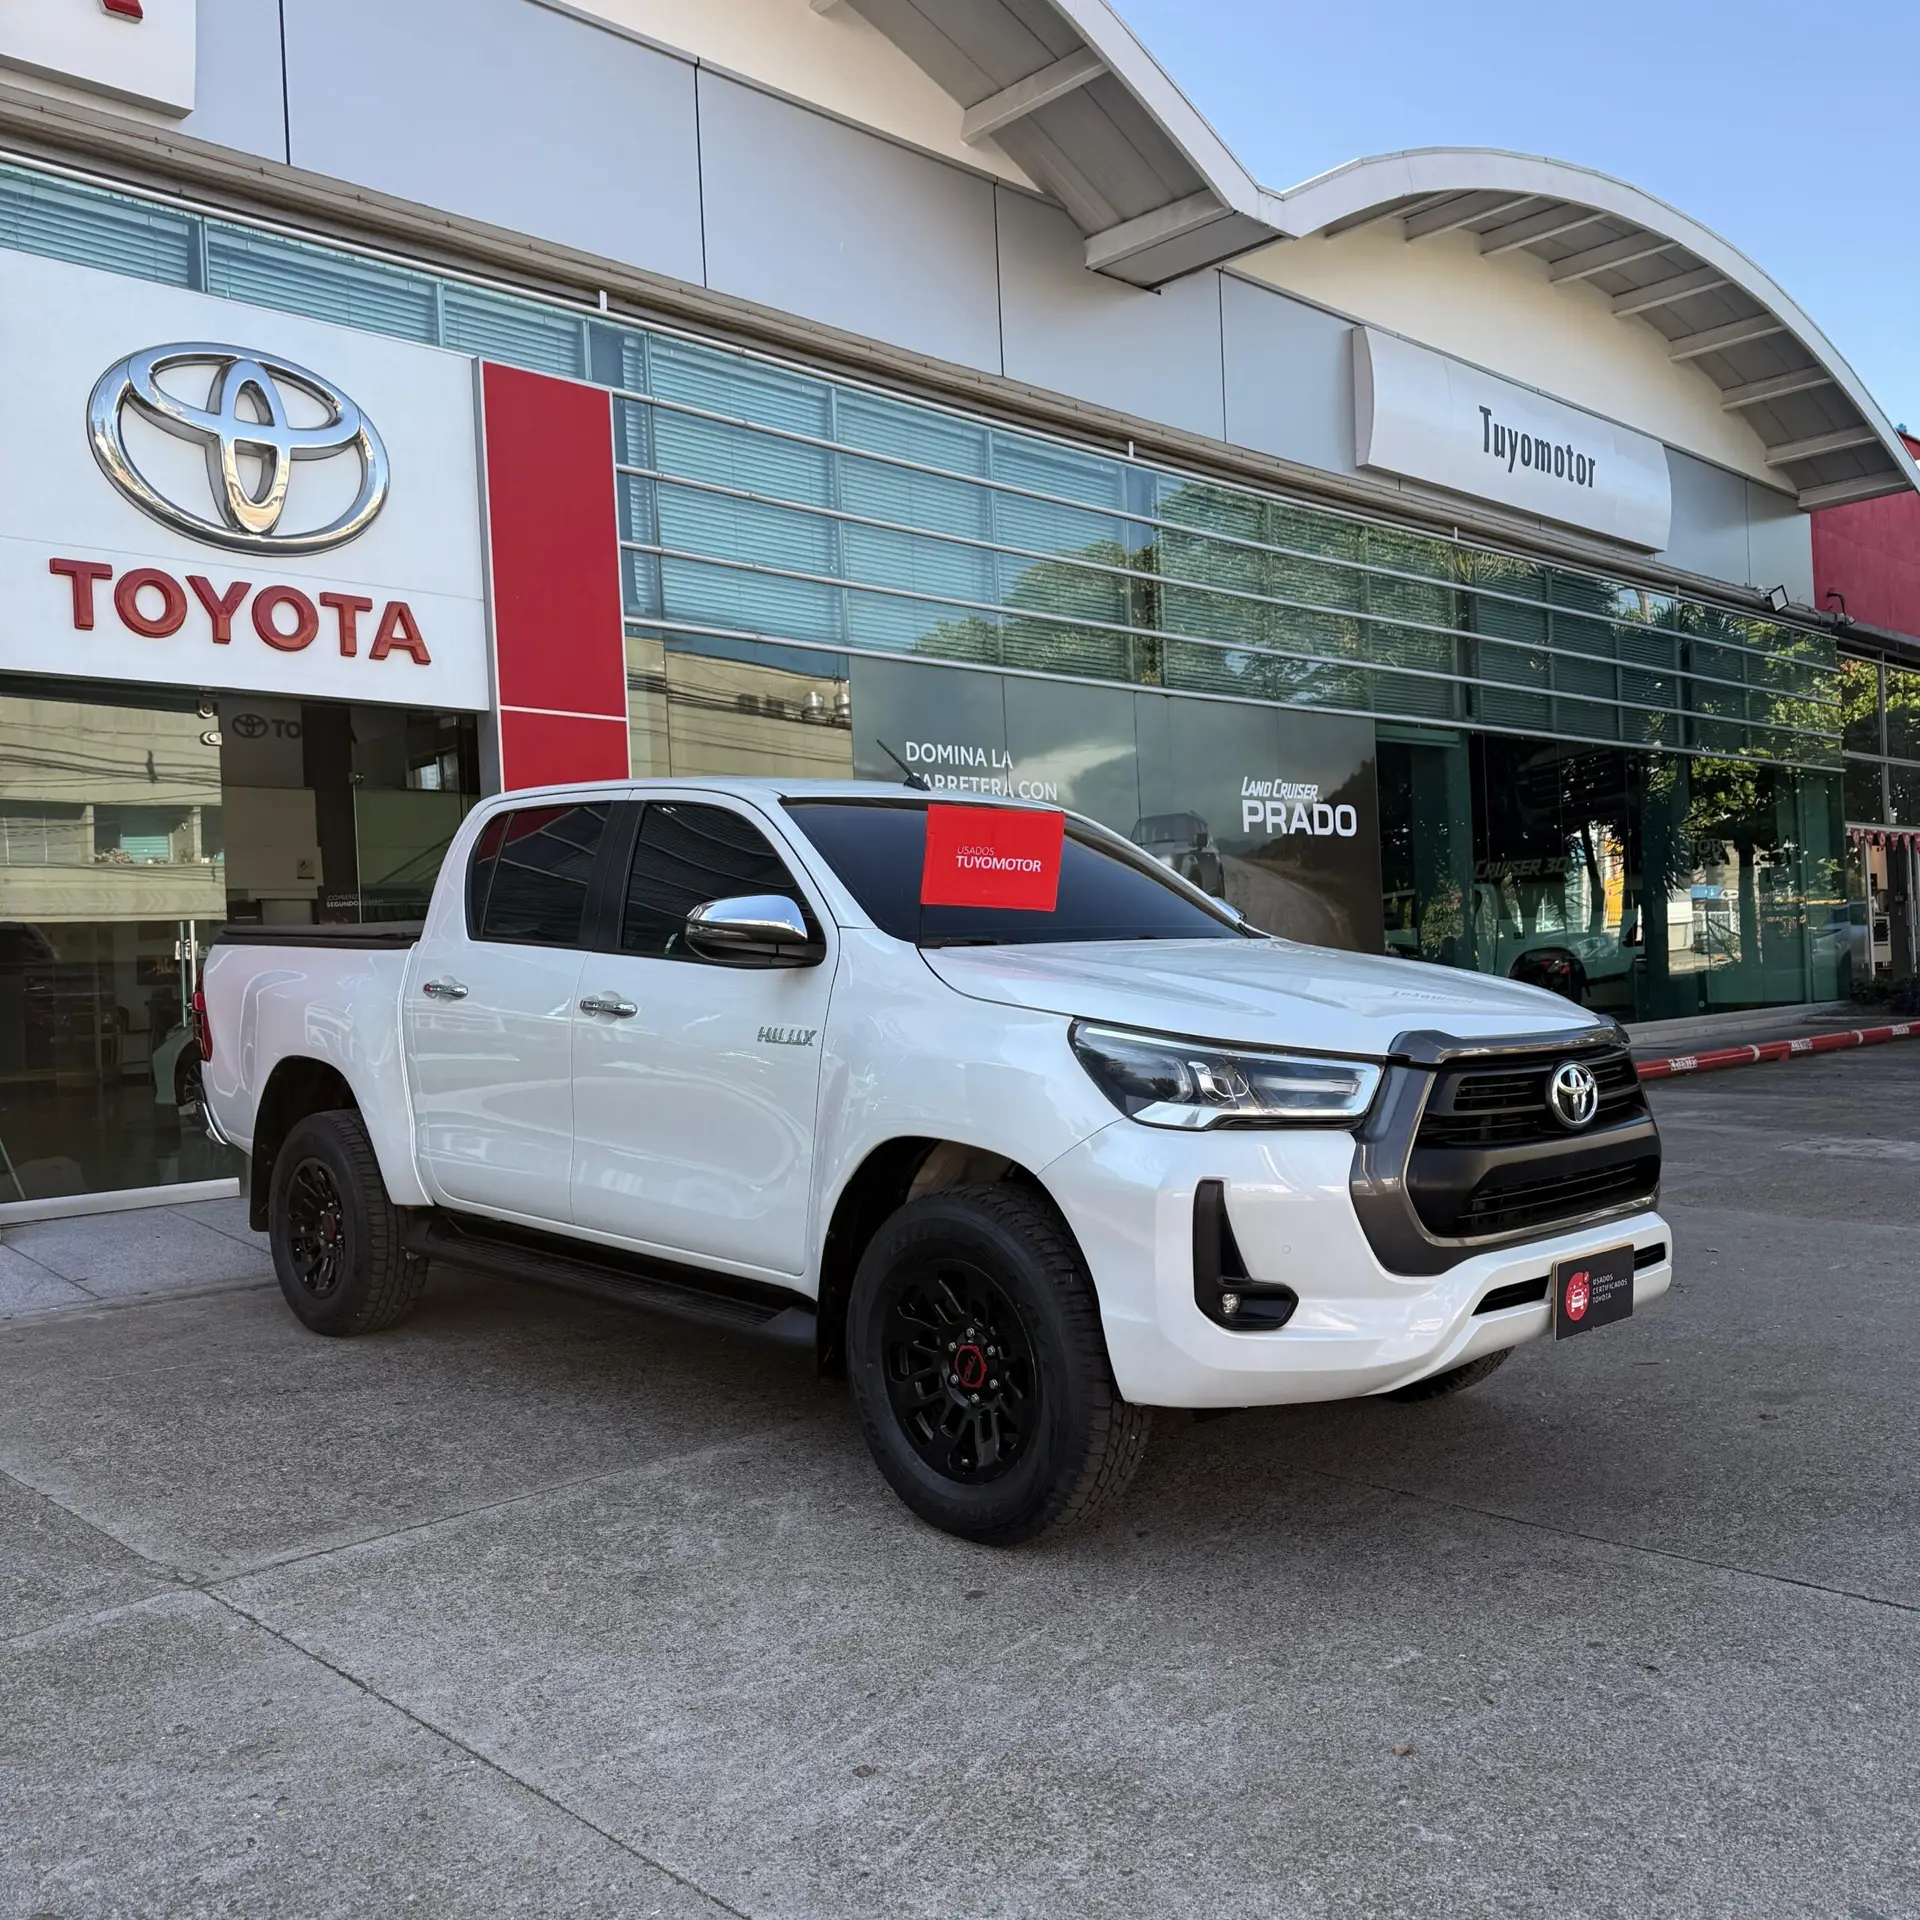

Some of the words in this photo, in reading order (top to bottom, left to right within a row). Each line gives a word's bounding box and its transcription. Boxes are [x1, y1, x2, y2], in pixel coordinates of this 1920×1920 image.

[1479, 405, 1596, 487] Tuyomotor
[49, 557, 432, 665] TOYOTA
[905, 741, 988, 767] DOMINA
[991, 748, 1014, 770] LA
[911, 772, 1014, 798] ARRETERA
[1018, 780, 1058, 800] CON
[1241, 776, 1272, 798] LAND
[1272, 778, 1318, 802] CRUISER
[1242, 799, 1357, 837] PRADO
[957, 845, 995, 856] USADOS
[956, 855, 1042, 872] TUYOMOTOR
[326, 900, 359, 908] SEGUNDO
[757, 1026, 818, 1047] HILUX
[1592, 1273, 1613, 1286] USADOS
[1592, 1278, 1628, 1295] CERTIFICADOS
[1592, 1292, 1612, 1304] TOYOTA
